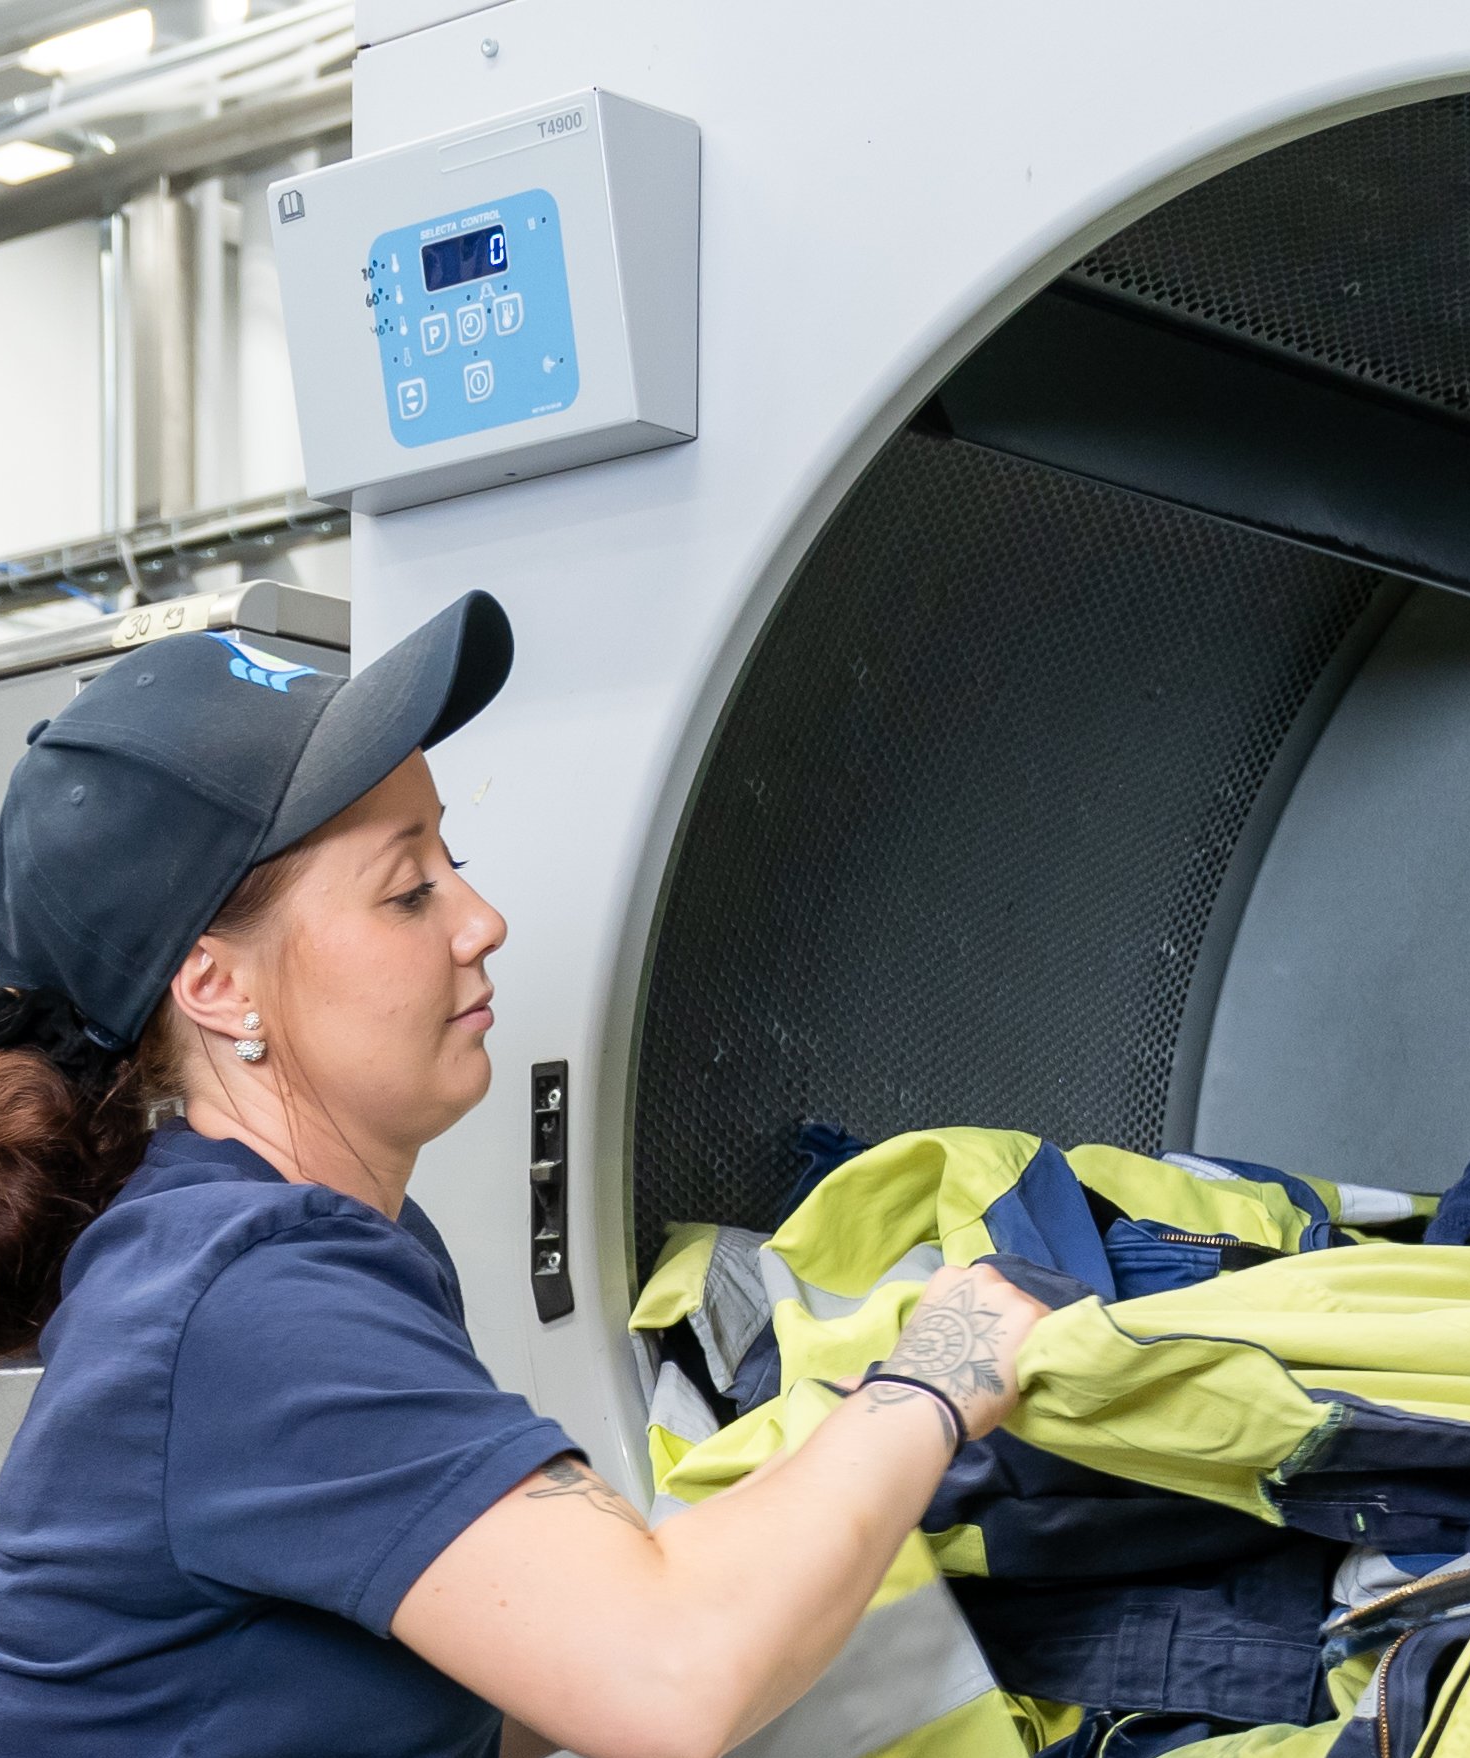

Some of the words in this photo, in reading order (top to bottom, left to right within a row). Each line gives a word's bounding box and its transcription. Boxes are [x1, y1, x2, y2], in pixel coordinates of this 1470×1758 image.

[537, 112, 582, 138] T4900
[420, 221, 457, 240] SELECTA
[460, 209, 501, 229] CONTROL
[489, 233, 505, 265] 0
[429, 325, 441, 345] P
[124, 612, 152, 640] 30
